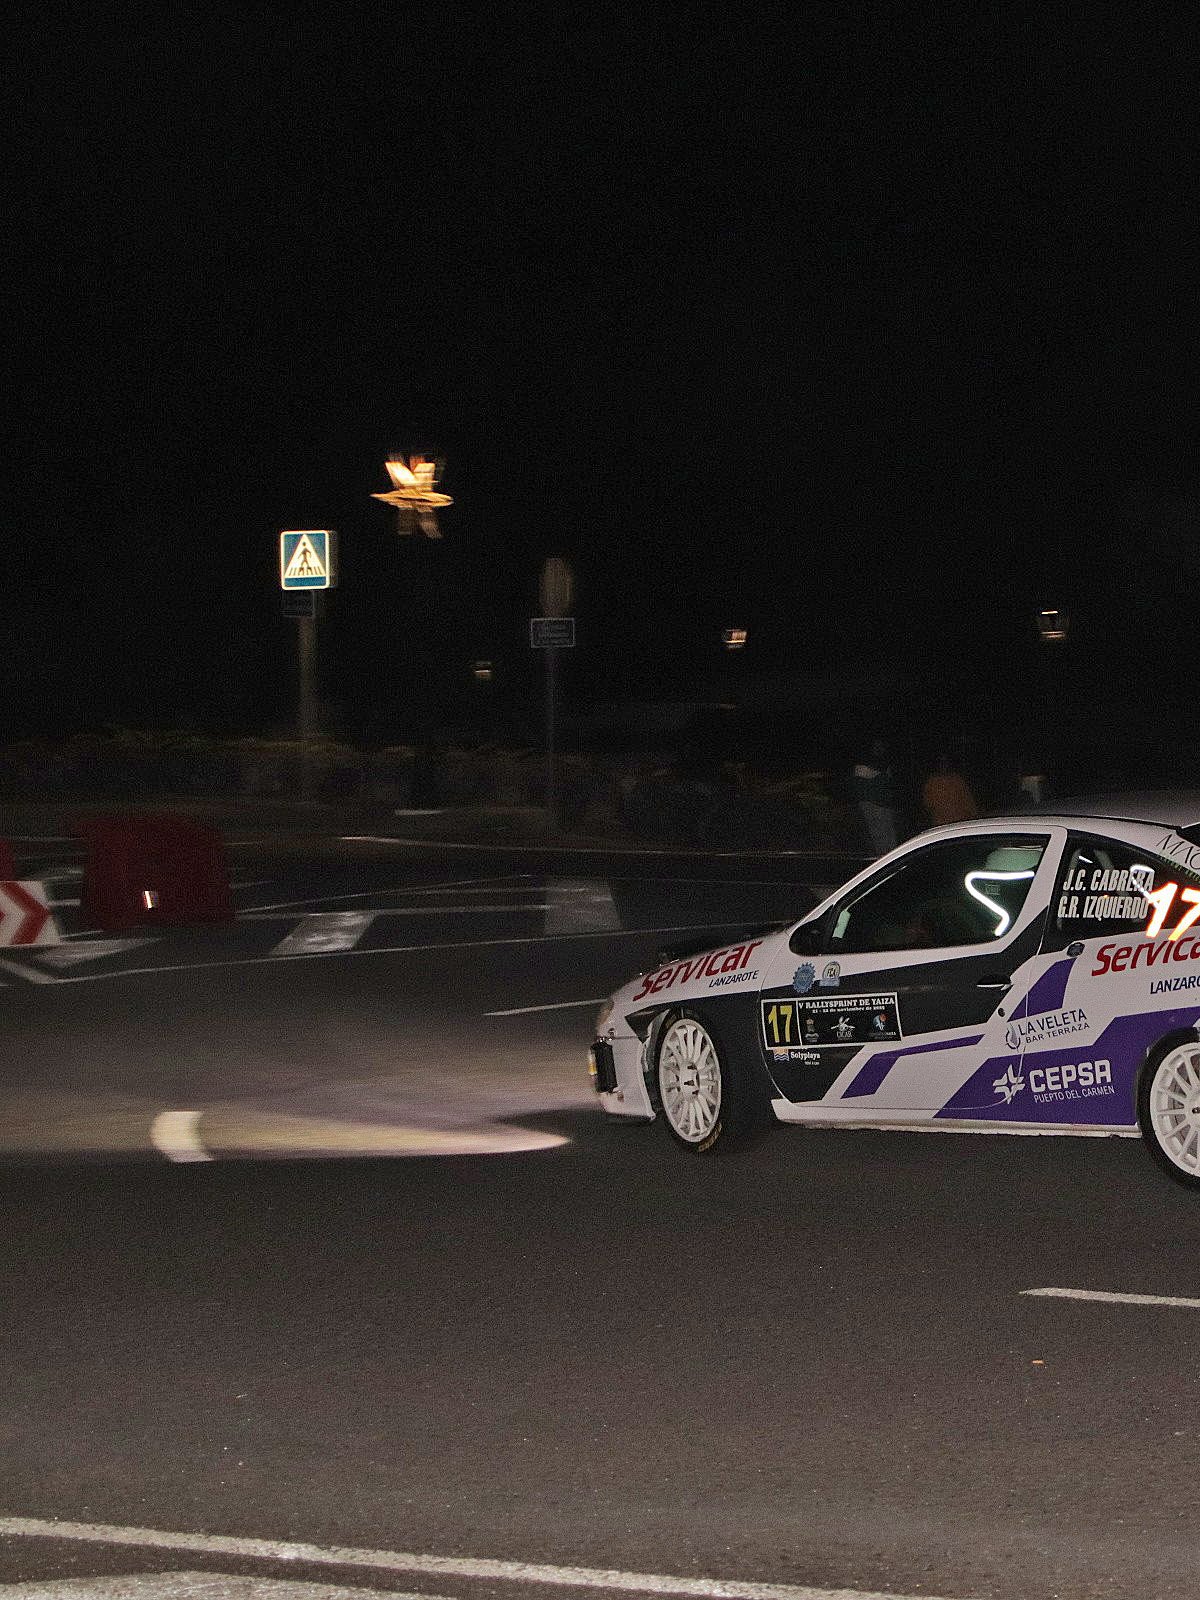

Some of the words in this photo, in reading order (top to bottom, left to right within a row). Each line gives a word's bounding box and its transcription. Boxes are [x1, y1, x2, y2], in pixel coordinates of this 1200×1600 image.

[1063, 869, 1086, 891] J.C.
[1090, 869, 1155, 891] CABRERA
[1058, 895, 1080, 918] G.R.
[1083, 895, 1149, 921] IZQUIERDO
[709, 970, 760, 988] LANZAROTE
[805, 1000, 858, 1009] RALLYSPRINT
[872, 997, 895, 1005] YAIZA
[768, 1005, 793, 1043] 17
[1018, 1021, 1036, 1036] LA
[1036, 1008, 1087, 1031] VELETA
[1025, 1034, 1044, 1043] BAR
[1047, 1022, 1090, 1038] TERRAZA
[790, 1052, 820, 1060] Solyplaya
[1029, 1060, 1112, 1093] CEPSA
[1034, 1091, 1065, 1103] PUERTO
[1067, 1089, 1081, 1099] DEL
[1082, 1085, 1115, 1097] CARMEN
